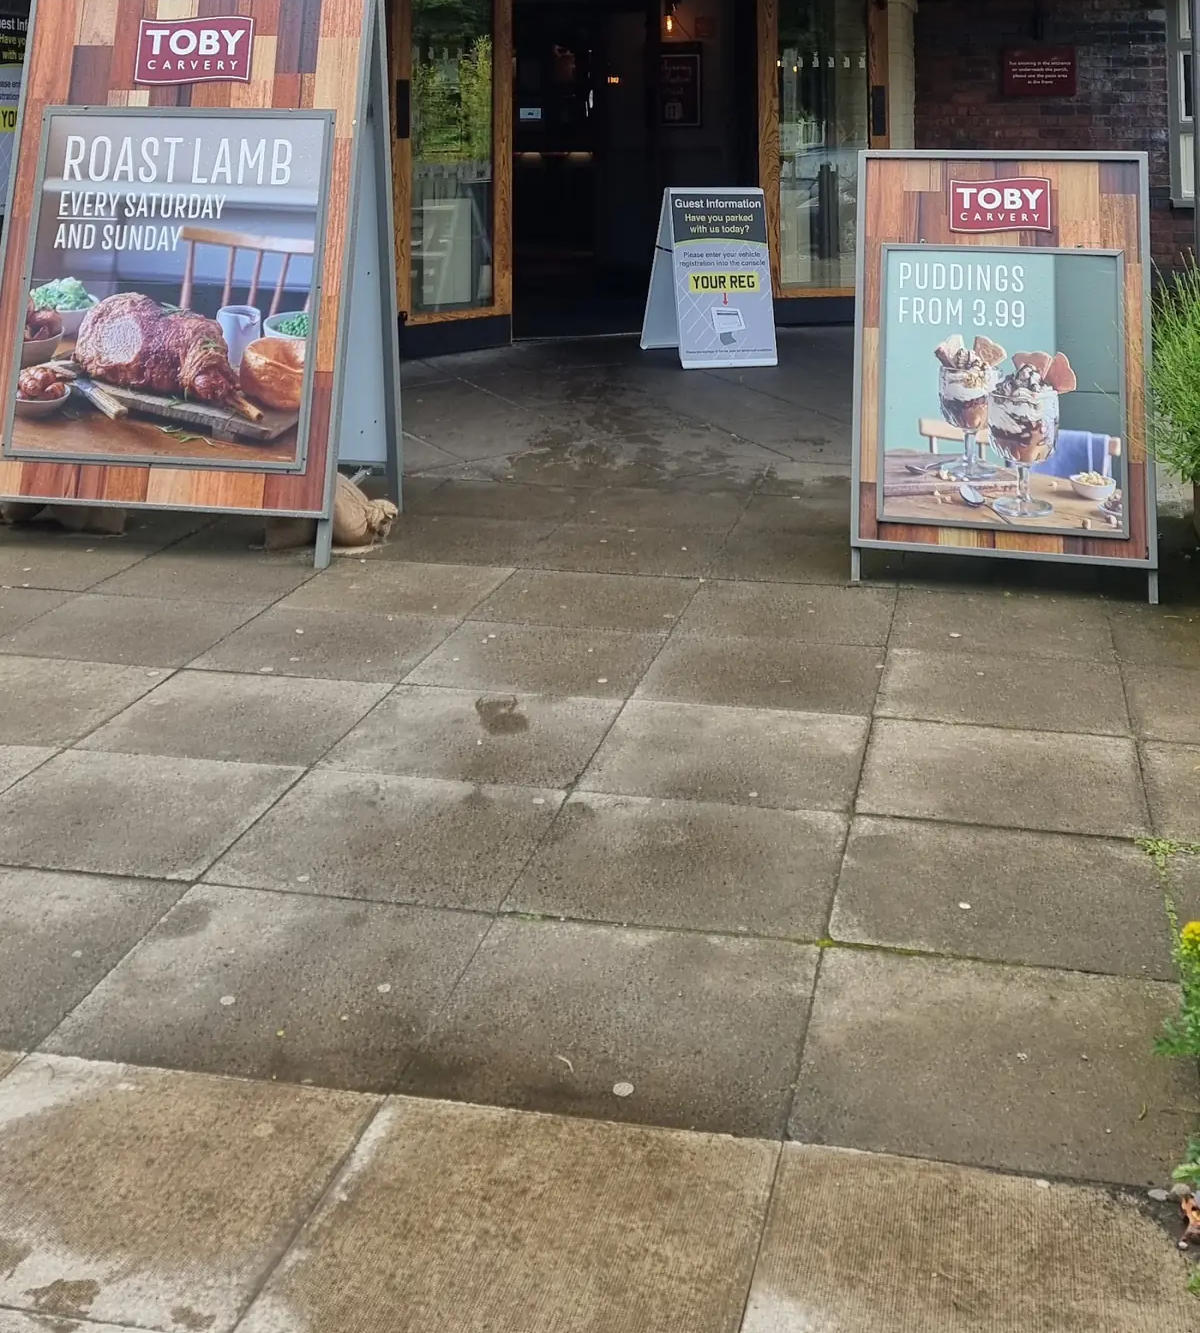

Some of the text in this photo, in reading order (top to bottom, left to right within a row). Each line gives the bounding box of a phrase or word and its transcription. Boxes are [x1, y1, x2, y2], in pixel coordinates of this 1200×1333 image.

[0, 18, 15, 31] est
[17, 37, 26, 48] yo
[145, 29, 246, 56] TOBY
[147, 59, 239, 71] CARVERY
[1, 110, 18, 128] YO
[62, 135, 293, 186] ROAST LAMB
[58, 191, 227, 219] EVERY SATURDAY
[674, 199, 762, 209] Guest Information
[956, 186, 1044, 211] TOBY
[685, 213, 754, 224] Have you parked
[960, 211, 1040, 222] CARVERY
[690, 225, 708, 233] with
[721, 225, 750, 235] today?
[53, 223, 183, 252] AND SUNDAY
[679, 260, 715, 268] registration
[692, 275, 755, 289] YOUR REG
[899, 262, 1025, 293] PUDDINGS
[898, 296, 1026, 328] FROM 3.99
